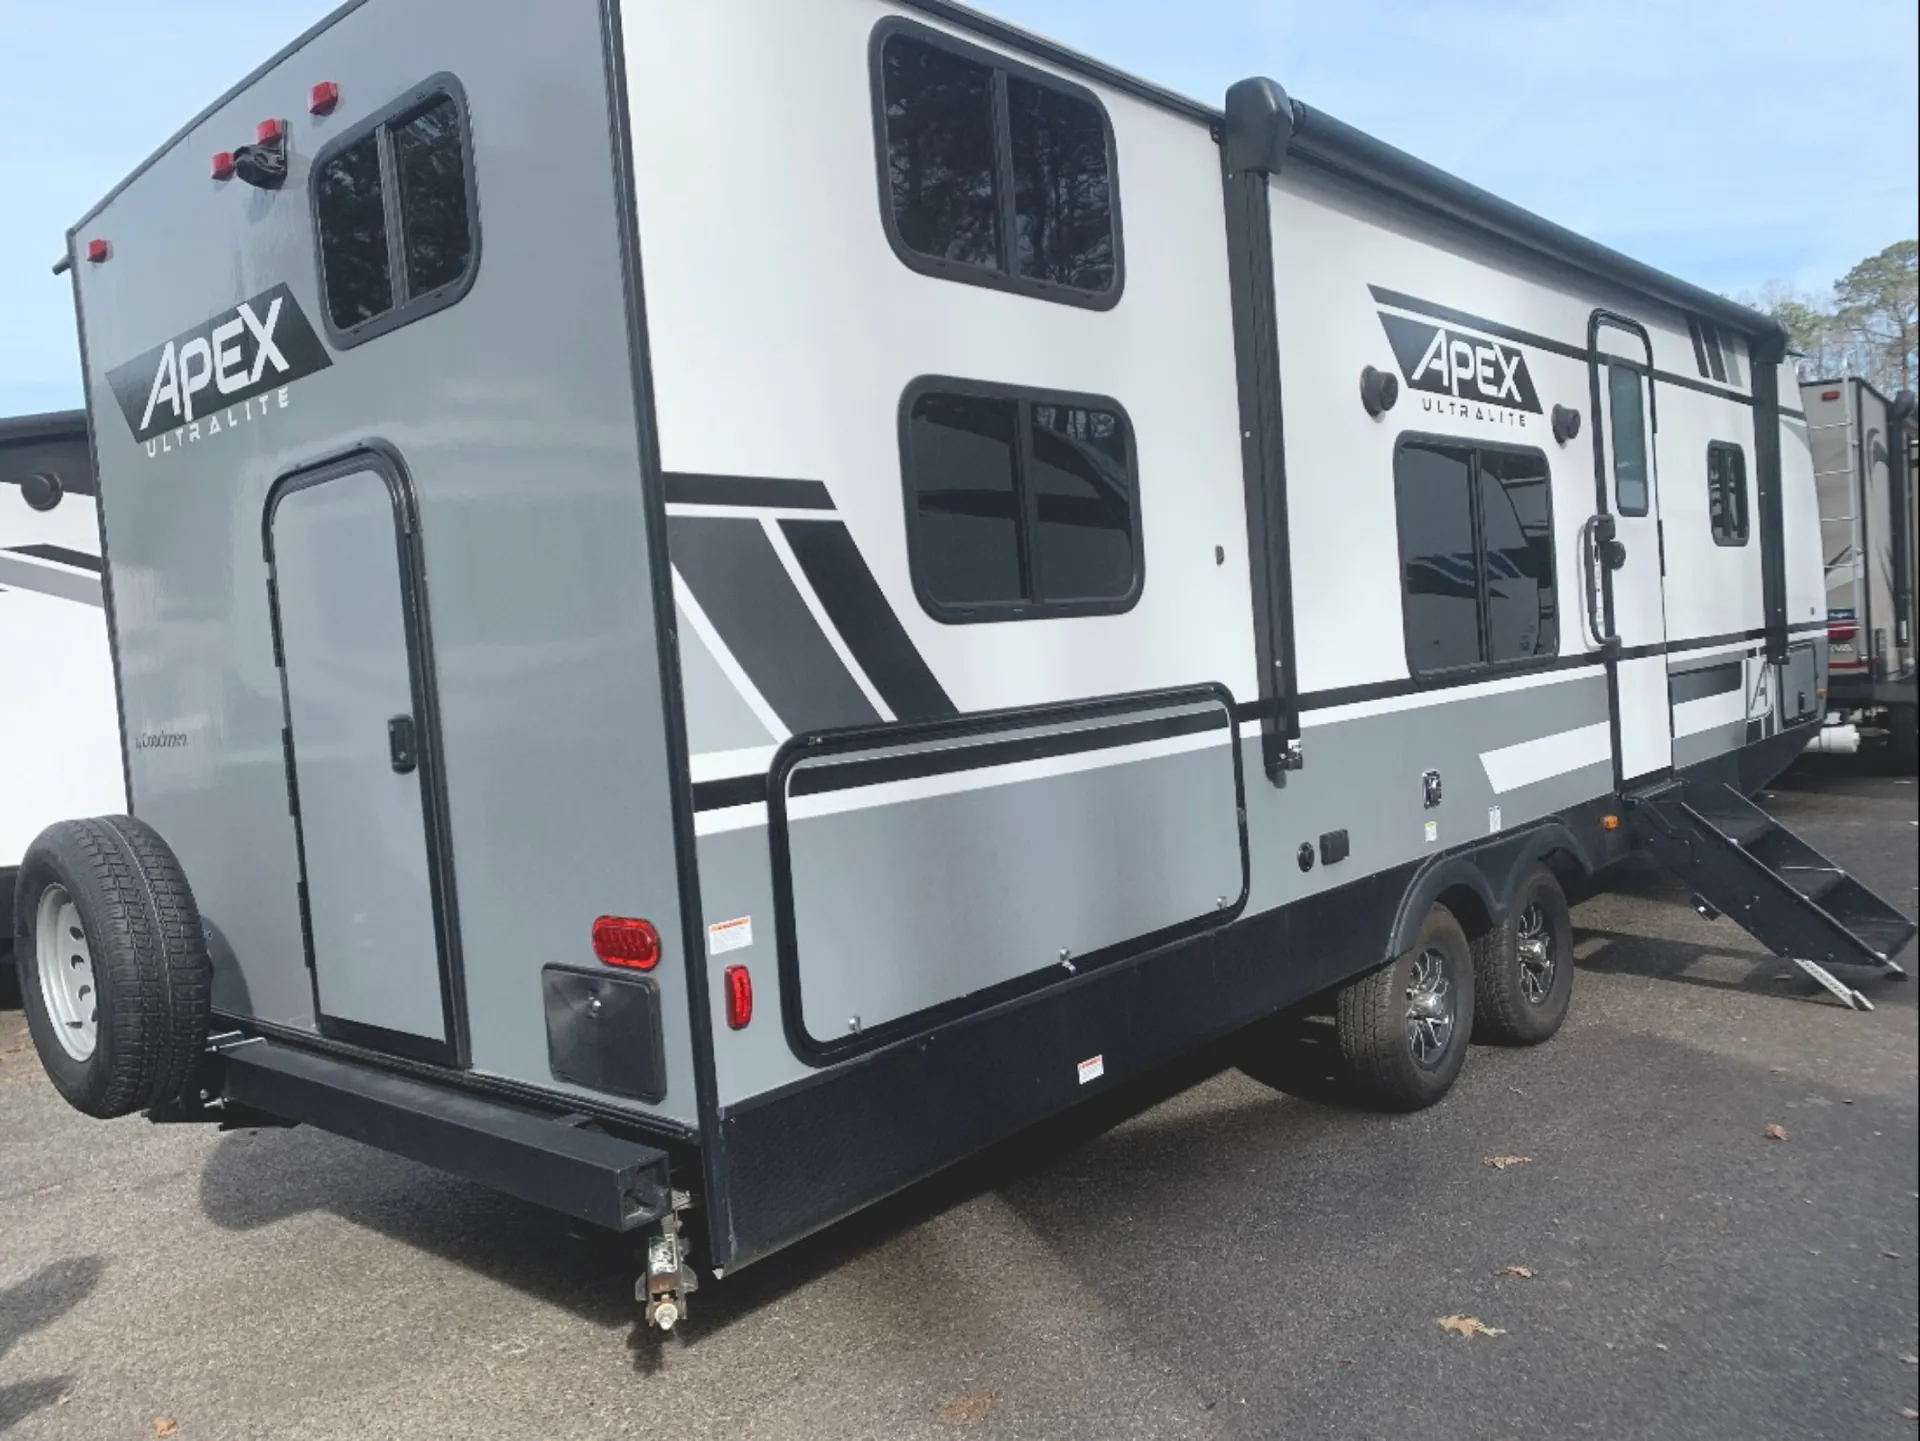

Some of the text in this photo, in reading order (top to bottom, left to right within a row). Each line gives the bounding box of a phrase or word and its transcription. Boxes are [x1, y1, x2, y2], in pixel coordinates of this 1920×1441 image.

[139, 296, 291, 431] APEX
[1411, 328, 1522, 403] APEX
[146, 386, 290, 459] ULTRALITE
[1422, 398, 1526, 428] ULTRALITE
